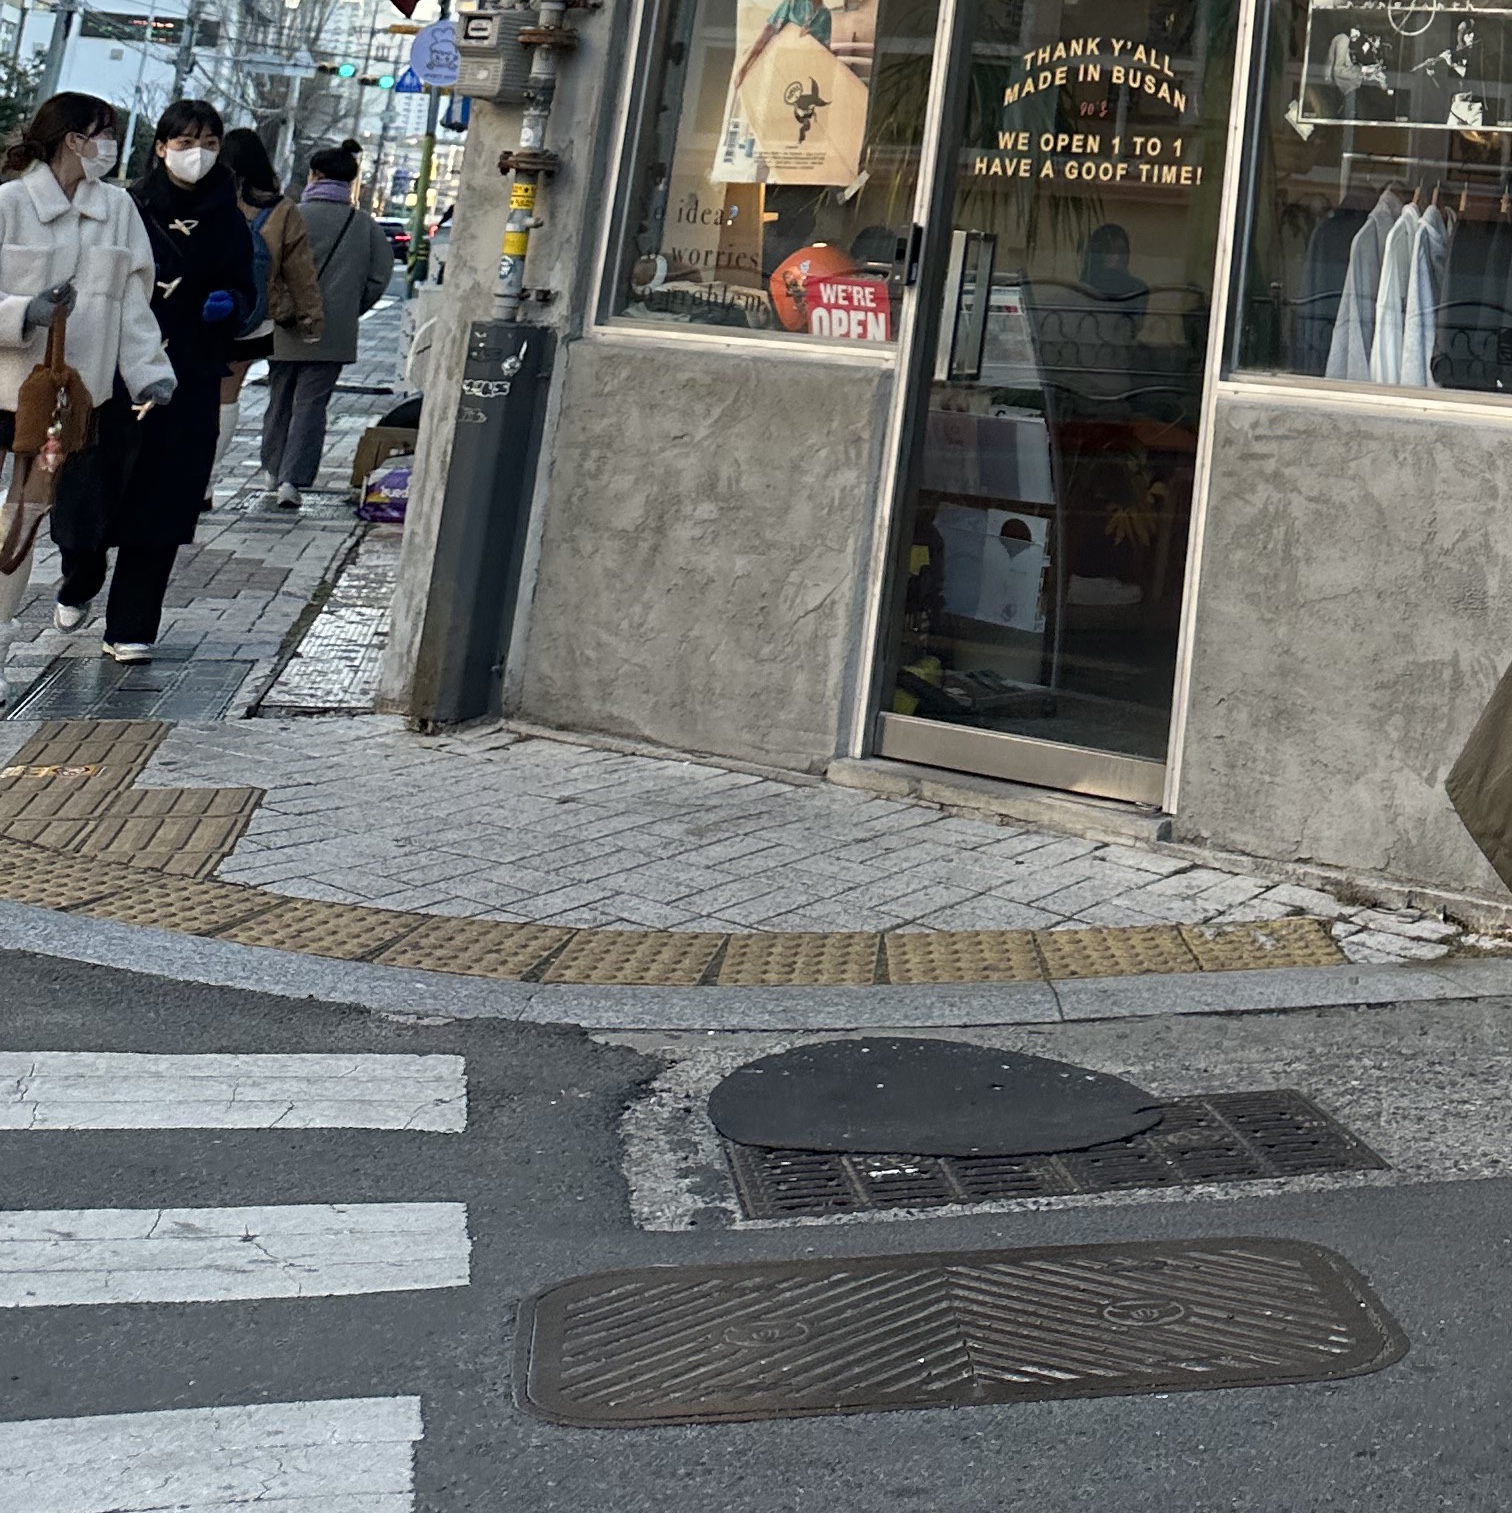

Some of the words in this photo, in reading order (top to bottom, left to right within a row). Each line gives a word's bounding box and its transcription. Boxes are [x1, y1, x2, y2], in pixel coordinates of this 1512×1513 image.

[1023, 37, 1103, 71] THANK
[1003, 66, 1069, 107] MADE
[1078, 64, 1101, 83] IN
[1111, 66, 1187, 113] BUSAN
[998, 131, 1031, 151] WE
[1040, 133, 1101, 154] OPEN
[1111, 138, 1120, 154] 1
[1133, 137, 1162, 156] TO
[1173, 138, 1183, 157] 1
[974, 157, 1033, 177] HAVE
[1040, 160, 1055, 178] A
[1065, 161, 1128, 181] GOOF
[1138, 164, 1203, 186] TIME!
[671, 243, 760, 269] worries
